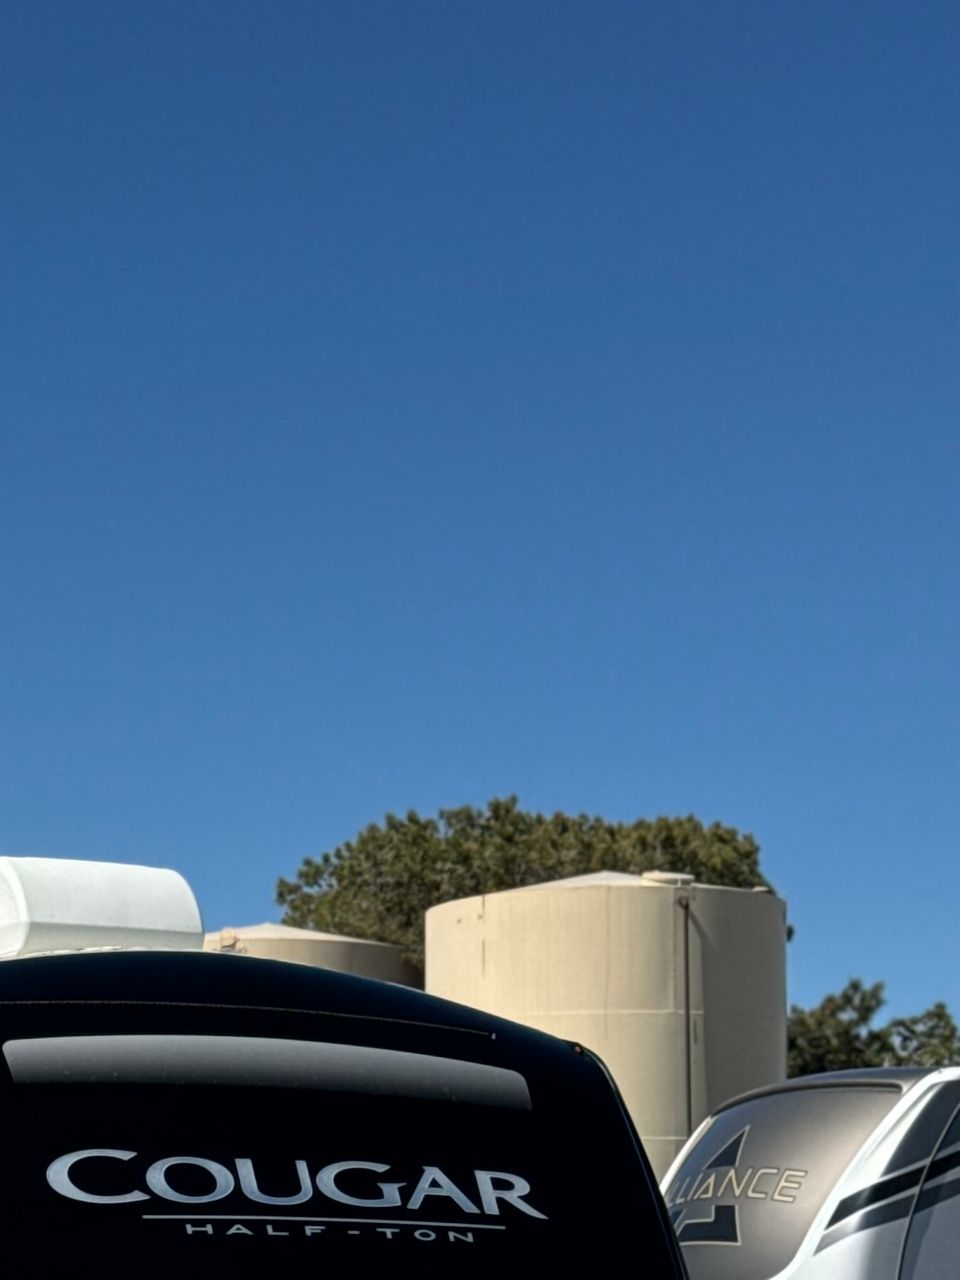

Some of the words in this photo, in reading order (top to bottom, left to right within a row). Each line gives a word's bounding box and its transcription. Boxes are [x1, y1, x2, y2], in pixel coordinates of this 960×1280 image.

[46, 1148, 549, 1220] COUGAR
[666, 1167, 808, 1206] LLIANCE
[185, 1222, 475, 1243] HALF-TON
